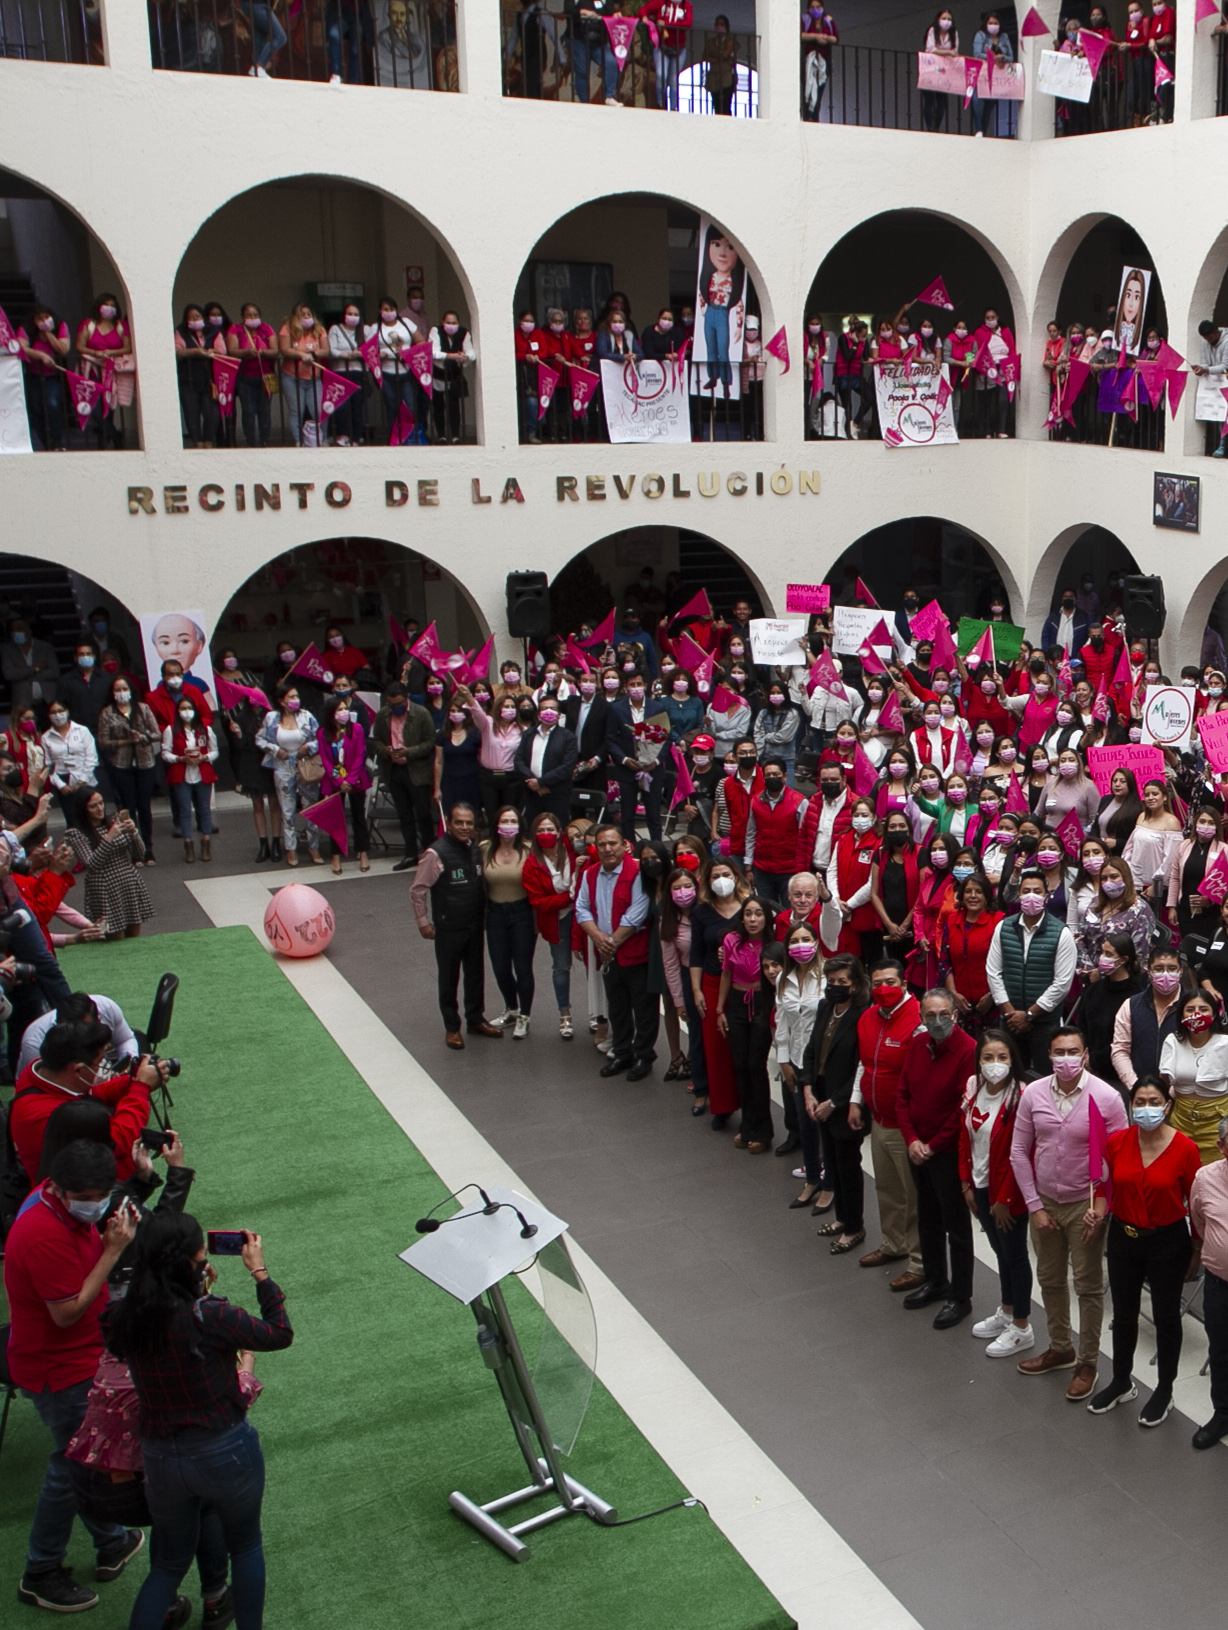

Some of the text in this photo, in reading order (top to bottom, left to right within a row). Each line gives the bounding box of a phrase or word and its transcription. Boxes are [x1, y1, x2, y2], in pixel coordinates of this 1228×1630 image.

[128, 464, 821, 514] RECINTO DE LA REVOLUCIÓN
[1151, 700, 1181, 720] Mujeres
